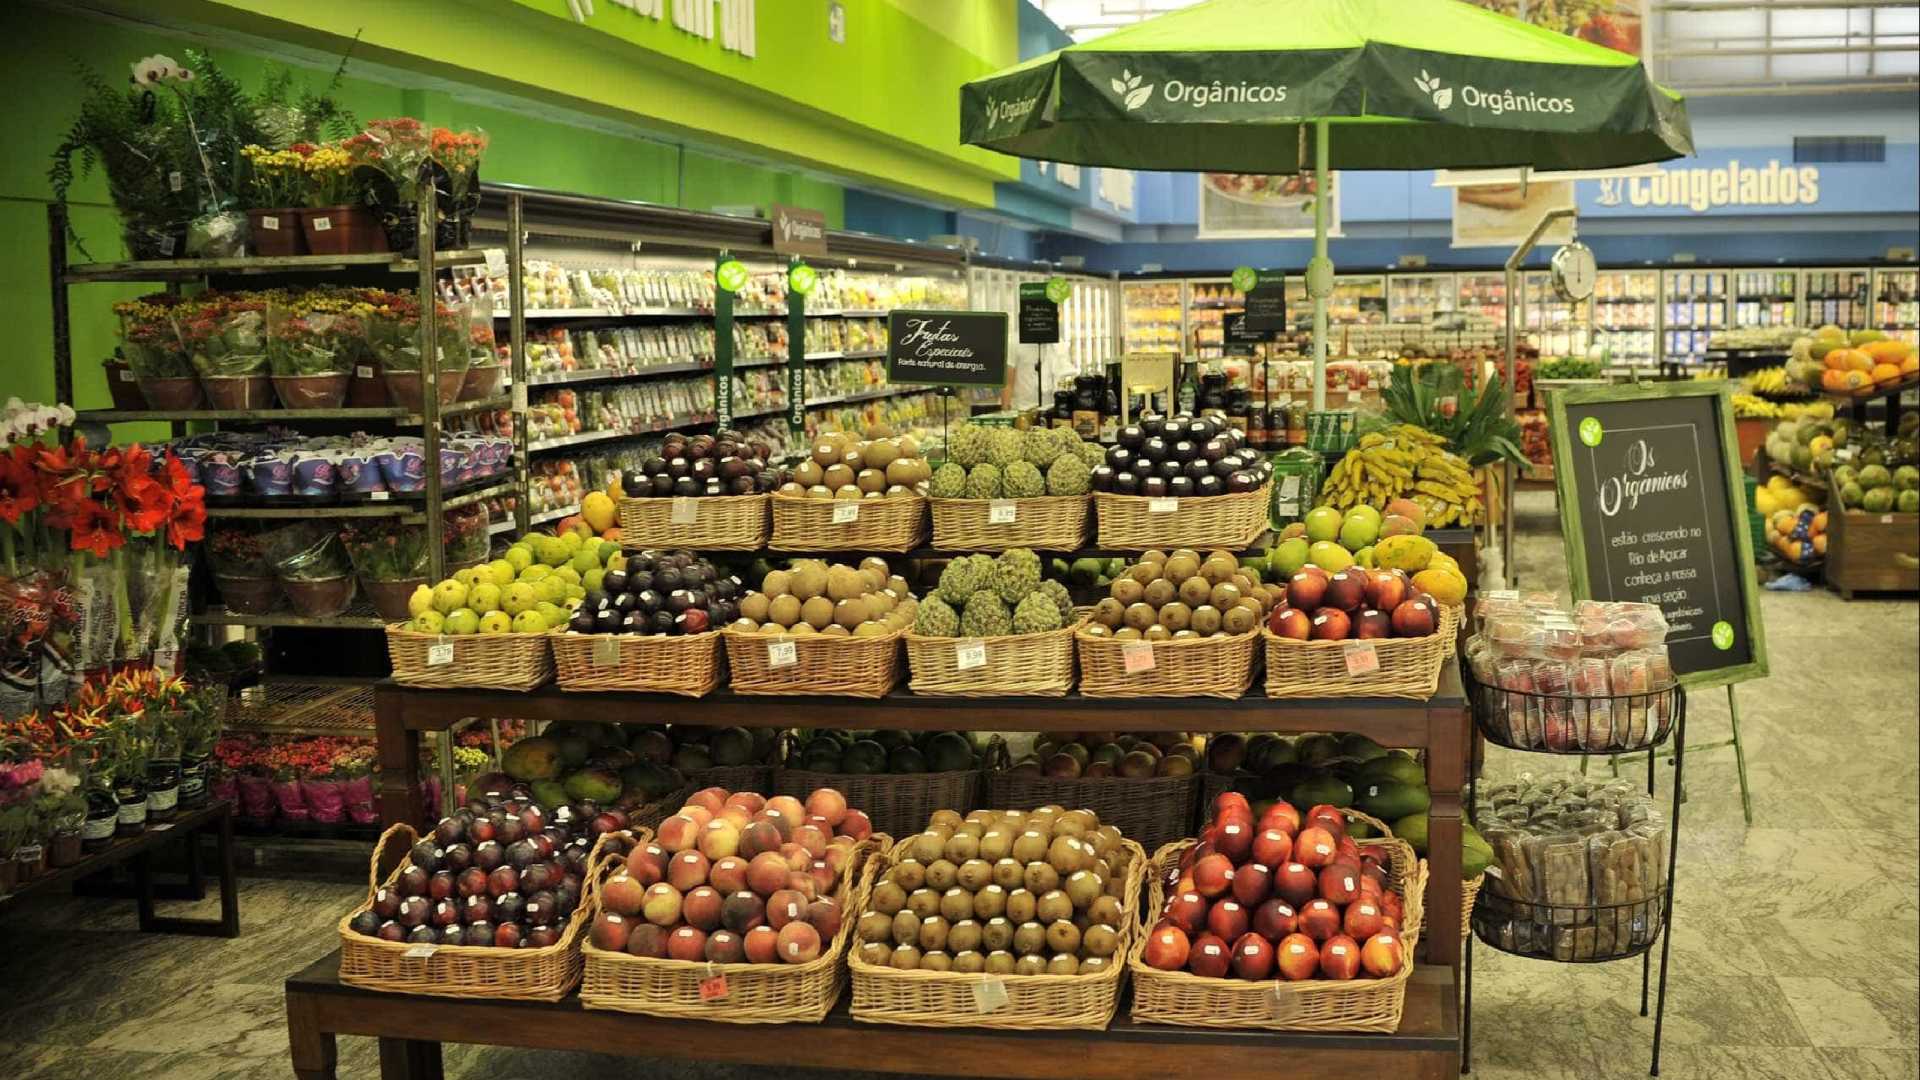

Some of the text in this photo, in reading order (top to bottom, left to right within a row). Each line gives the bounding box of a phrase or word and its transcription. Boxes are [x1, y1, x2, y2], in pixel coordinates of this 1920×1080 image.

[1163, 80, 1287, 107] Orgânicos
[1461, 85, 1575, 115] Orgânicos
[1628, 160, 1819, 212] Congelados
[900, 319, 960, 345] Frutas
[792, 368, 805, 424] Orgânicos
[1627, 440, 1655, 475] Os
[1600, 469, 1689, 516] Orgânicos
[1611, 530, 1638, 547] estão
[1690, 528, 1702, 537] no
[1624, 570, 1662, 588] conheça
